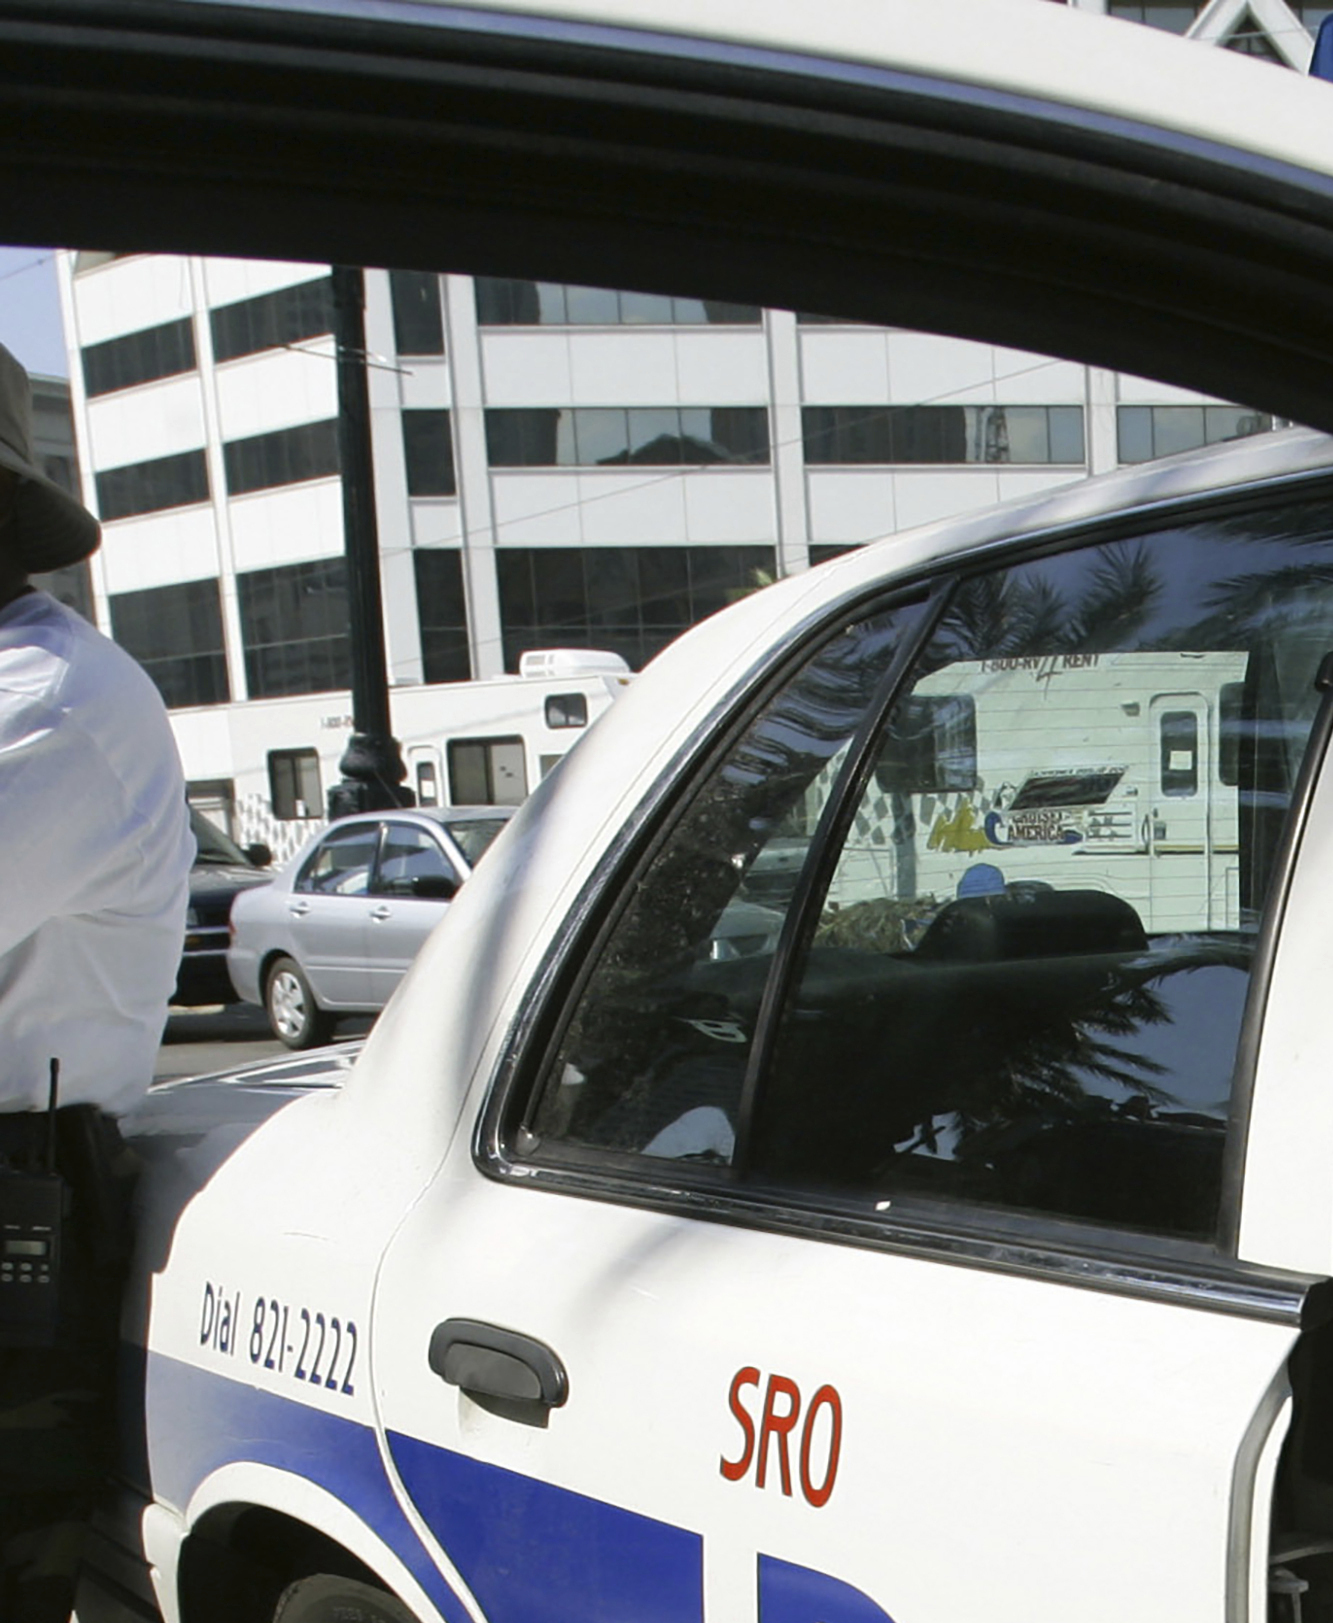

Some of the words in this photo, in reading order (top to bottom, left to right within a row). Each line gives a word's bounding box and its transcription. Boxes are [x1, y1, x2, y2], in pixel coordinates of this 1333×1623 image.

[1007, 824, 1065, 841] AMERICA
[200, 1281, 240, 1356] Dial
[249, 1296, 358, 1397] 821-2222
[719, 1365, 844, 1509] SRO
